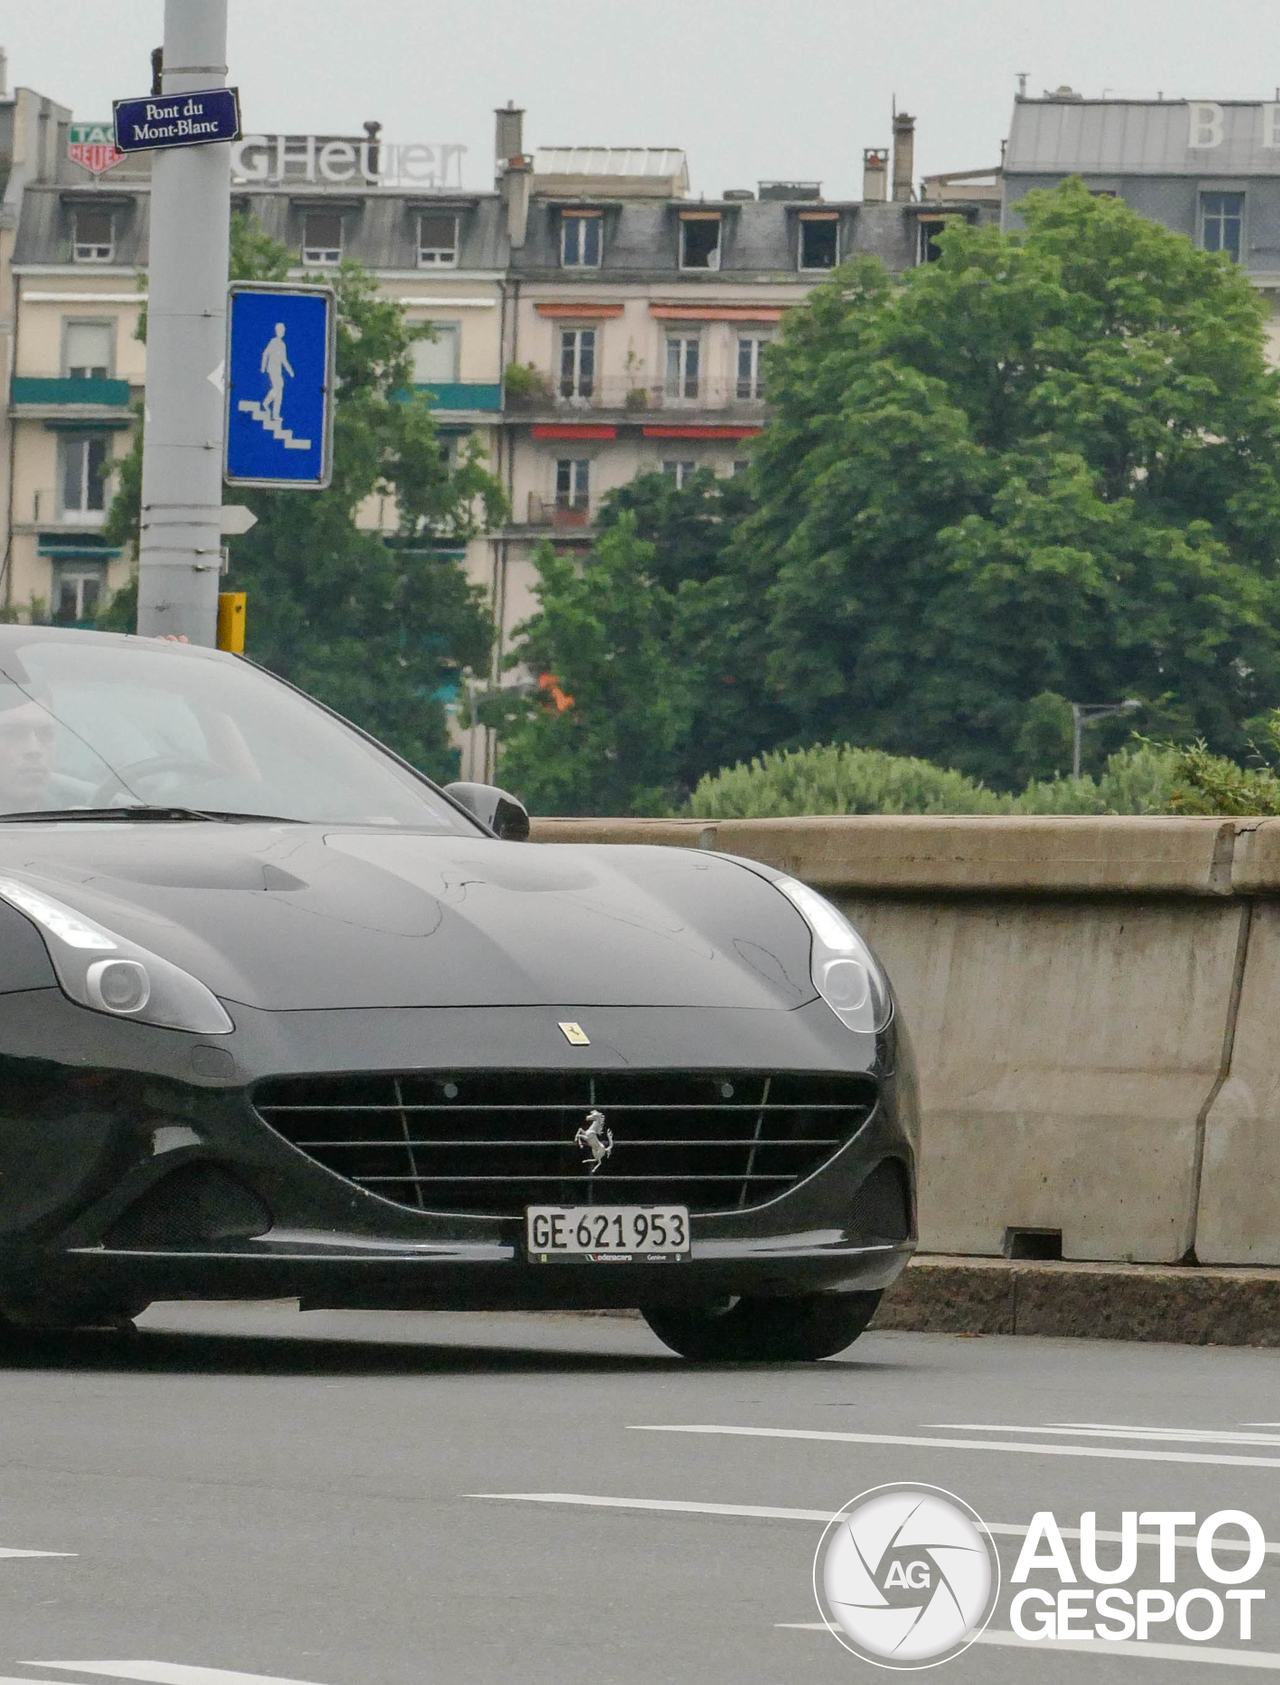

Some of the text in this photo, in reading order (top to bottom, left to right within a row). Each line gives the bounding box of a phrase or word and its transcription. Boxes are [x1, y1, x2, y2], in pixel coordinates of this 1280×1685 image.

[146, 99, 203, 121] Pont du
[133, 121, 218, 141] Mont-Blanc
